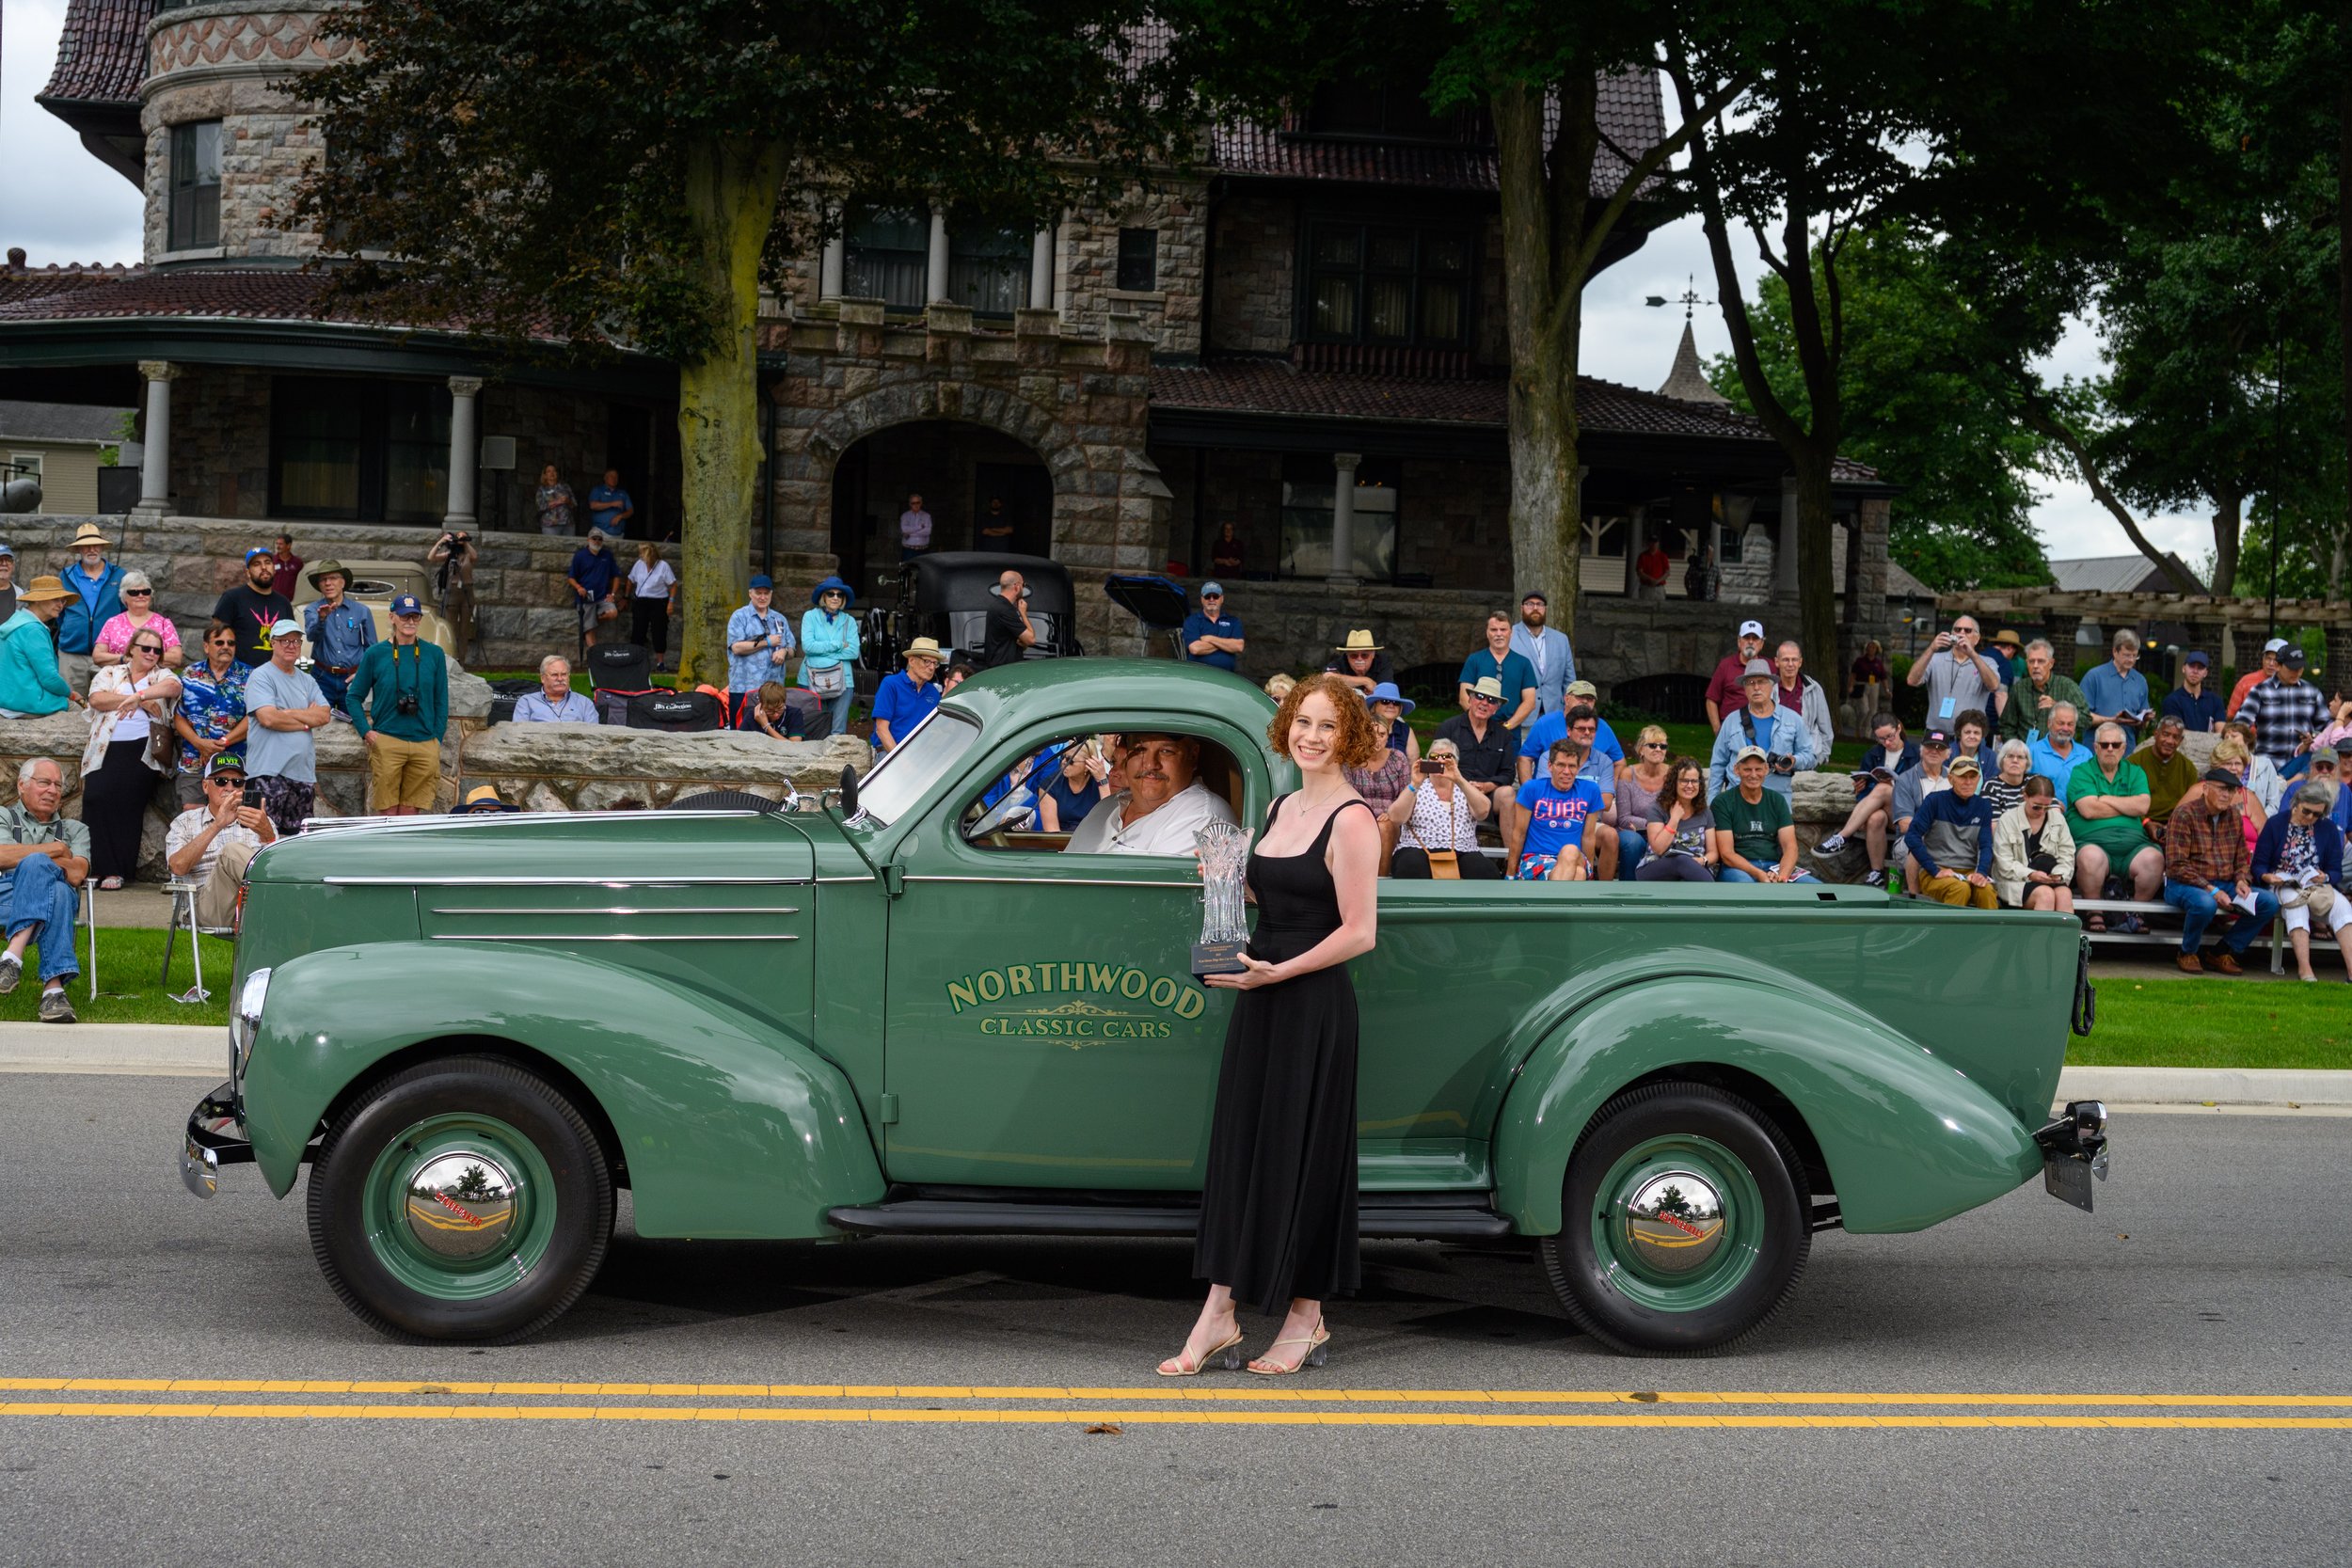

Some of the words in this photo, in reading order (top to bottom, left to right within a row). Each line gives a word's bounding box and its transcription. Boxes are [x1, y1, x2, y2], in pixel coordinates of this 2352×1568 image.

[1534, 799, 1588, 821] CUBS
[946, 961, 1207, 1021] NORTHWOOD
[979, 1017, 1094, 1037] CLASSIC
[1102, 1020, 1172, 1039] CARS
[434, 1190, 483, 1228] STUDEBAKER
